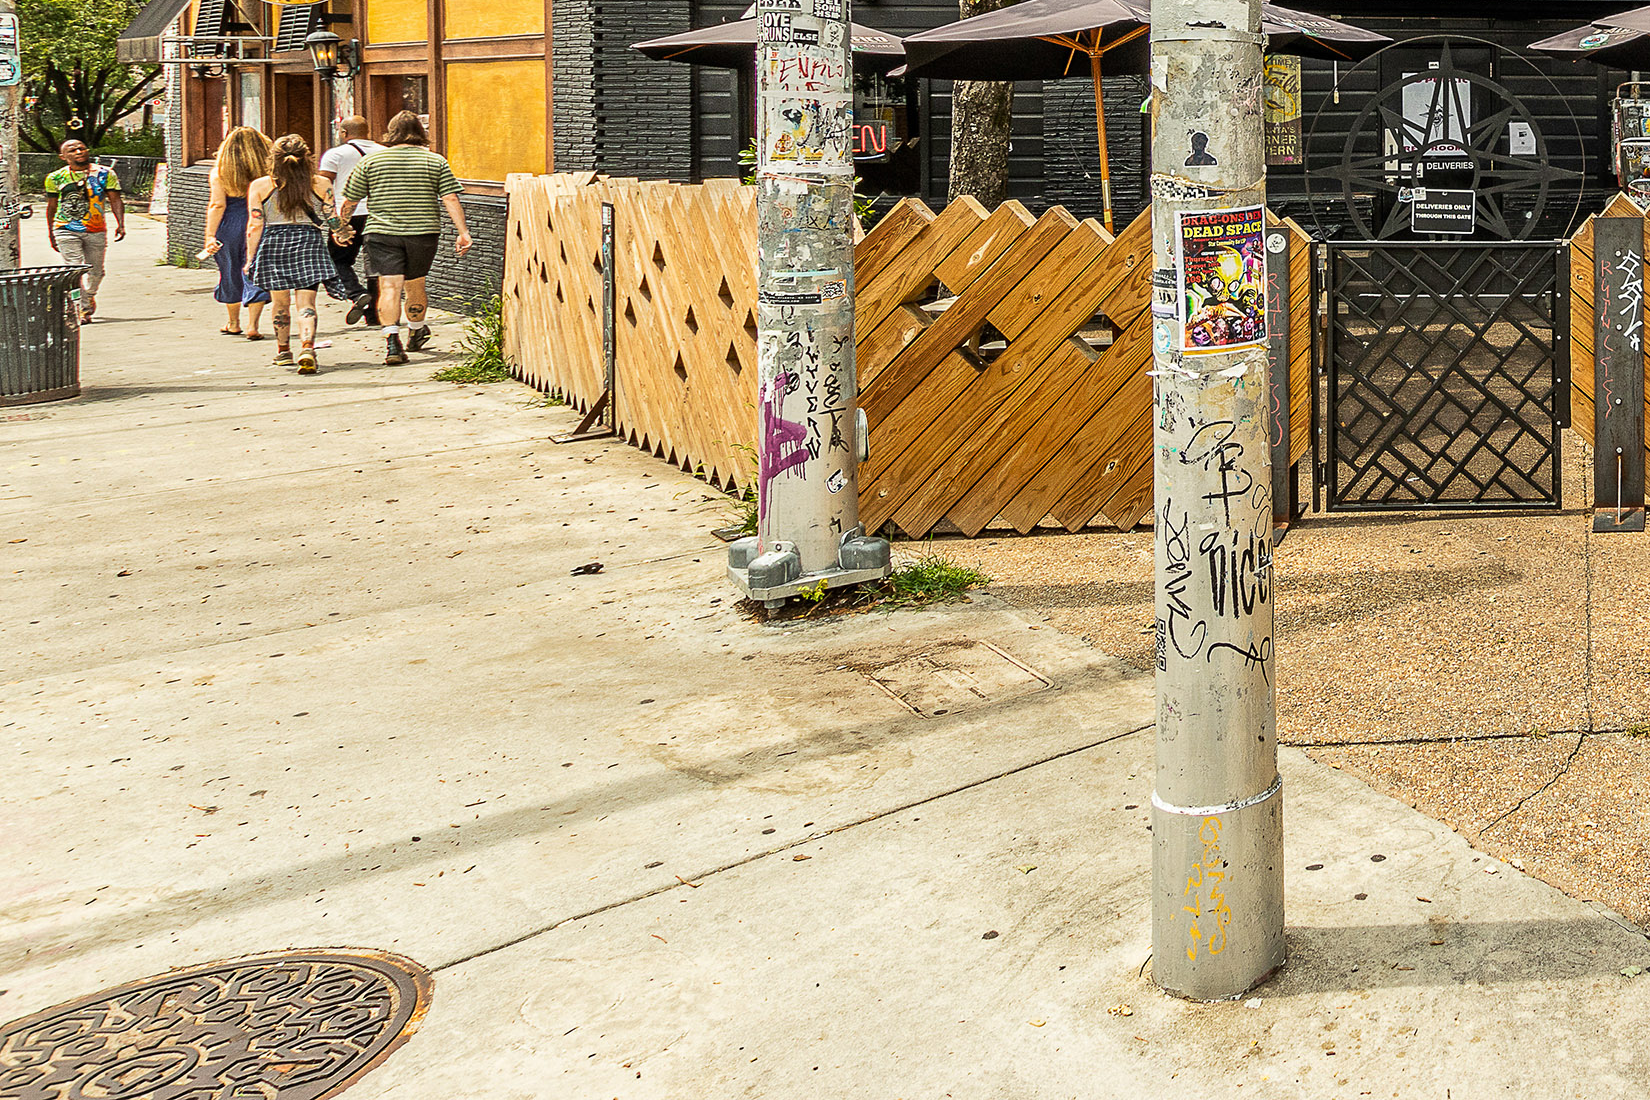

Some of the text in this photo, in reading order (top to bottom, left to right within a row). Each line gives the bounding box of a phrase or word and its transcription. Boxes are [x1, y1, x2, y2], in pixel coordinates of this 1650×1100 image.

[1426, 161, 1475, 170] DELIVERIES
[1415, 203, 1453, 211] DELIVERIES
[1183, 220, 1262, 239] DEAD SPACE
